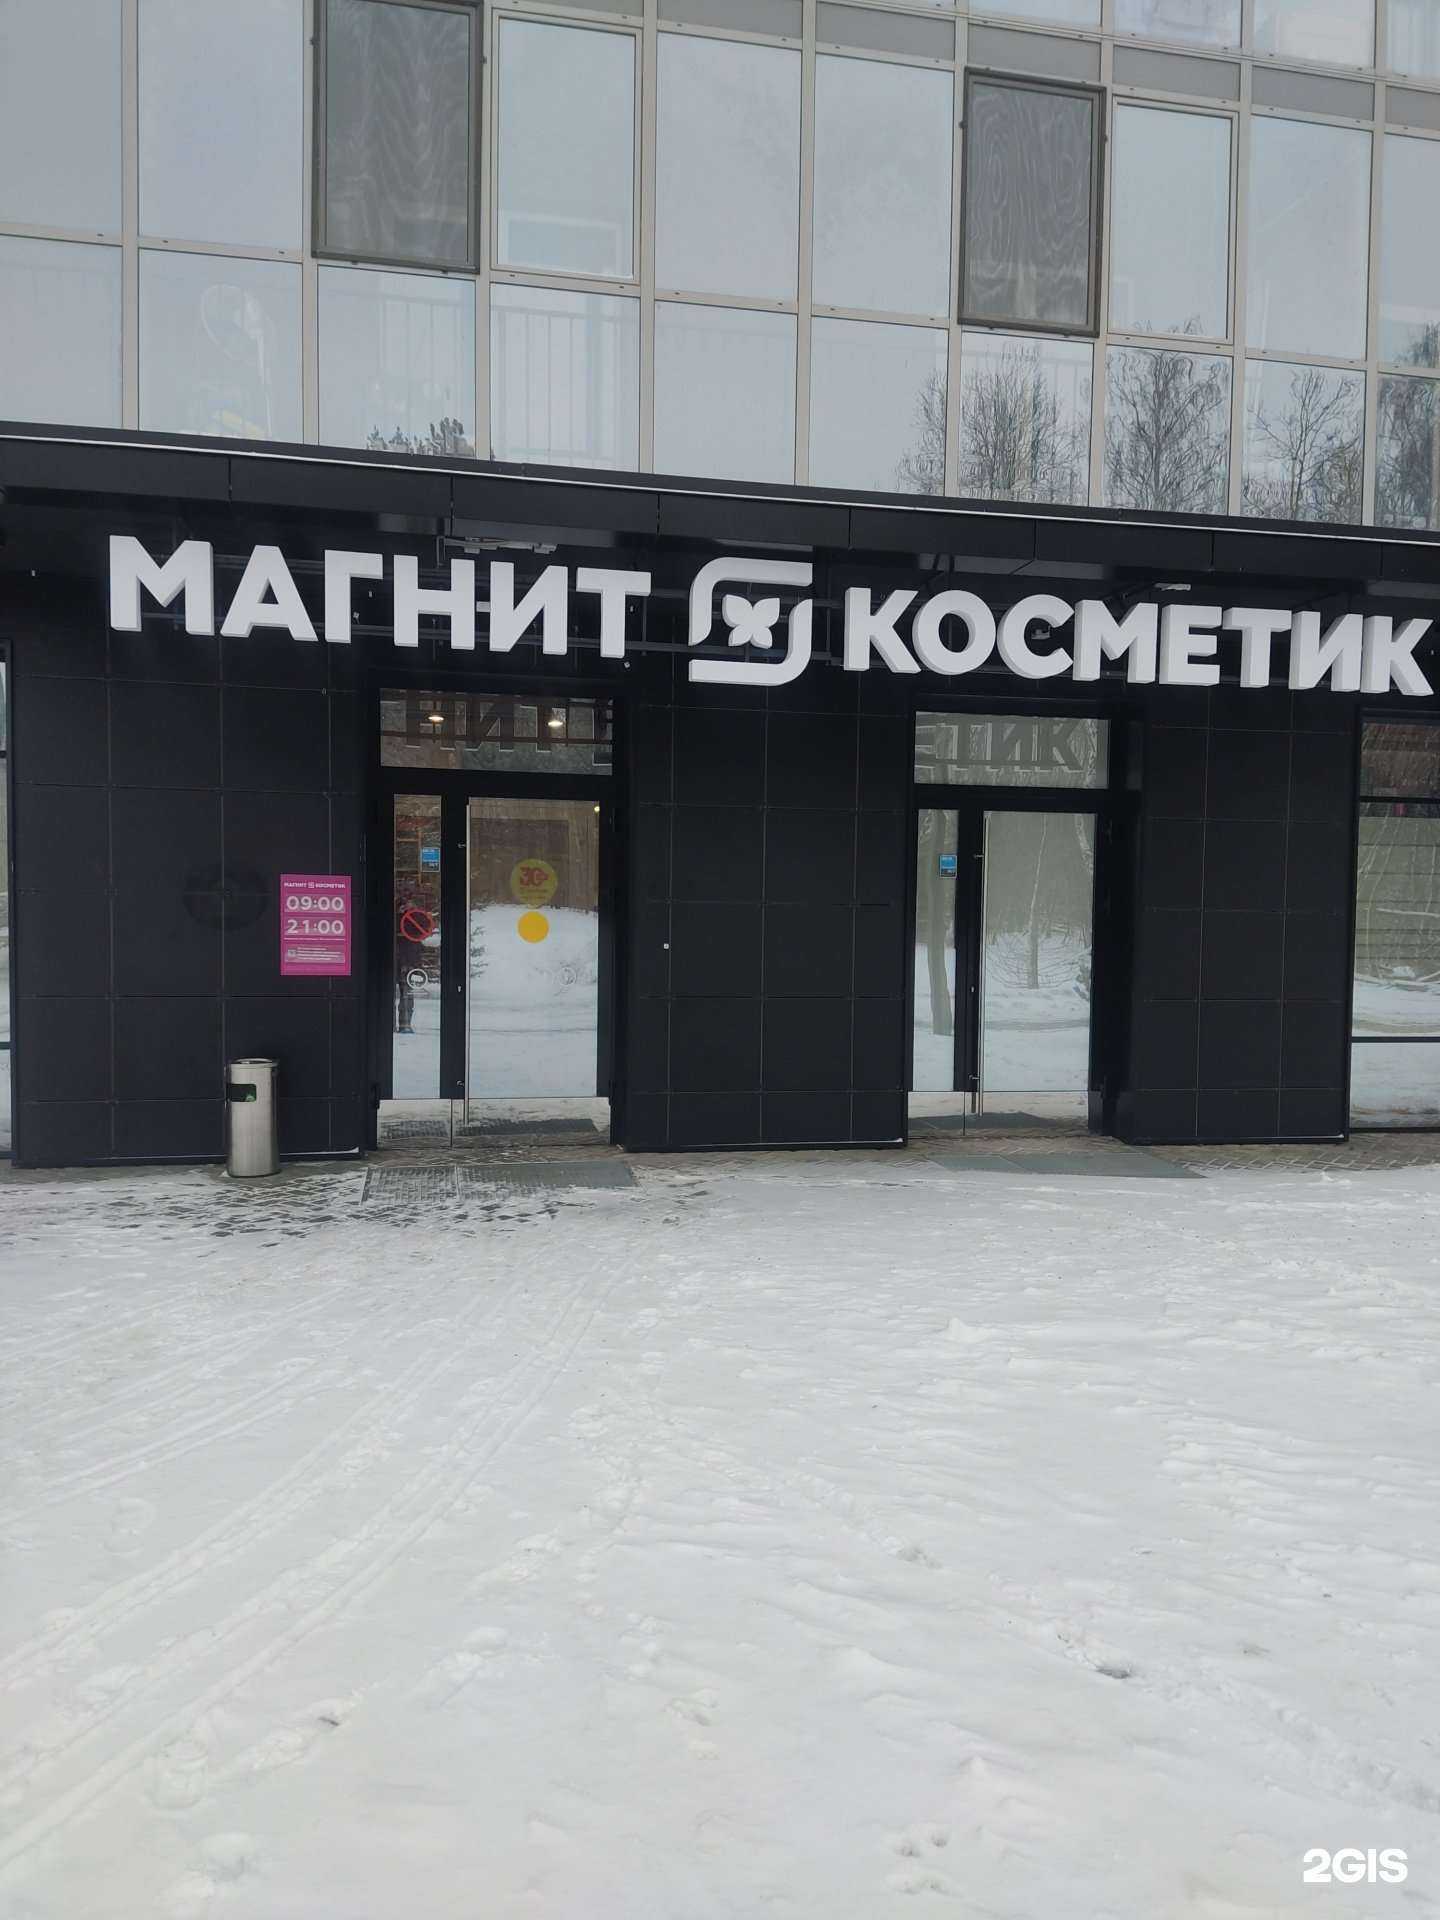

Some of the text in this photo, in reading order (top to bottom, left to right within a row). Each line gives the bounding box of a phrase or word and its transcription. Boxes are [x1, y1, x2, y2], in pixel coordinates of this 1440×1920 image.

[109, 534, 1434, 696] МАГНИТ КОСМЕТИК
[286, 895, 344, 911] 09:00
[287, 919, 344, 935] 21:00
